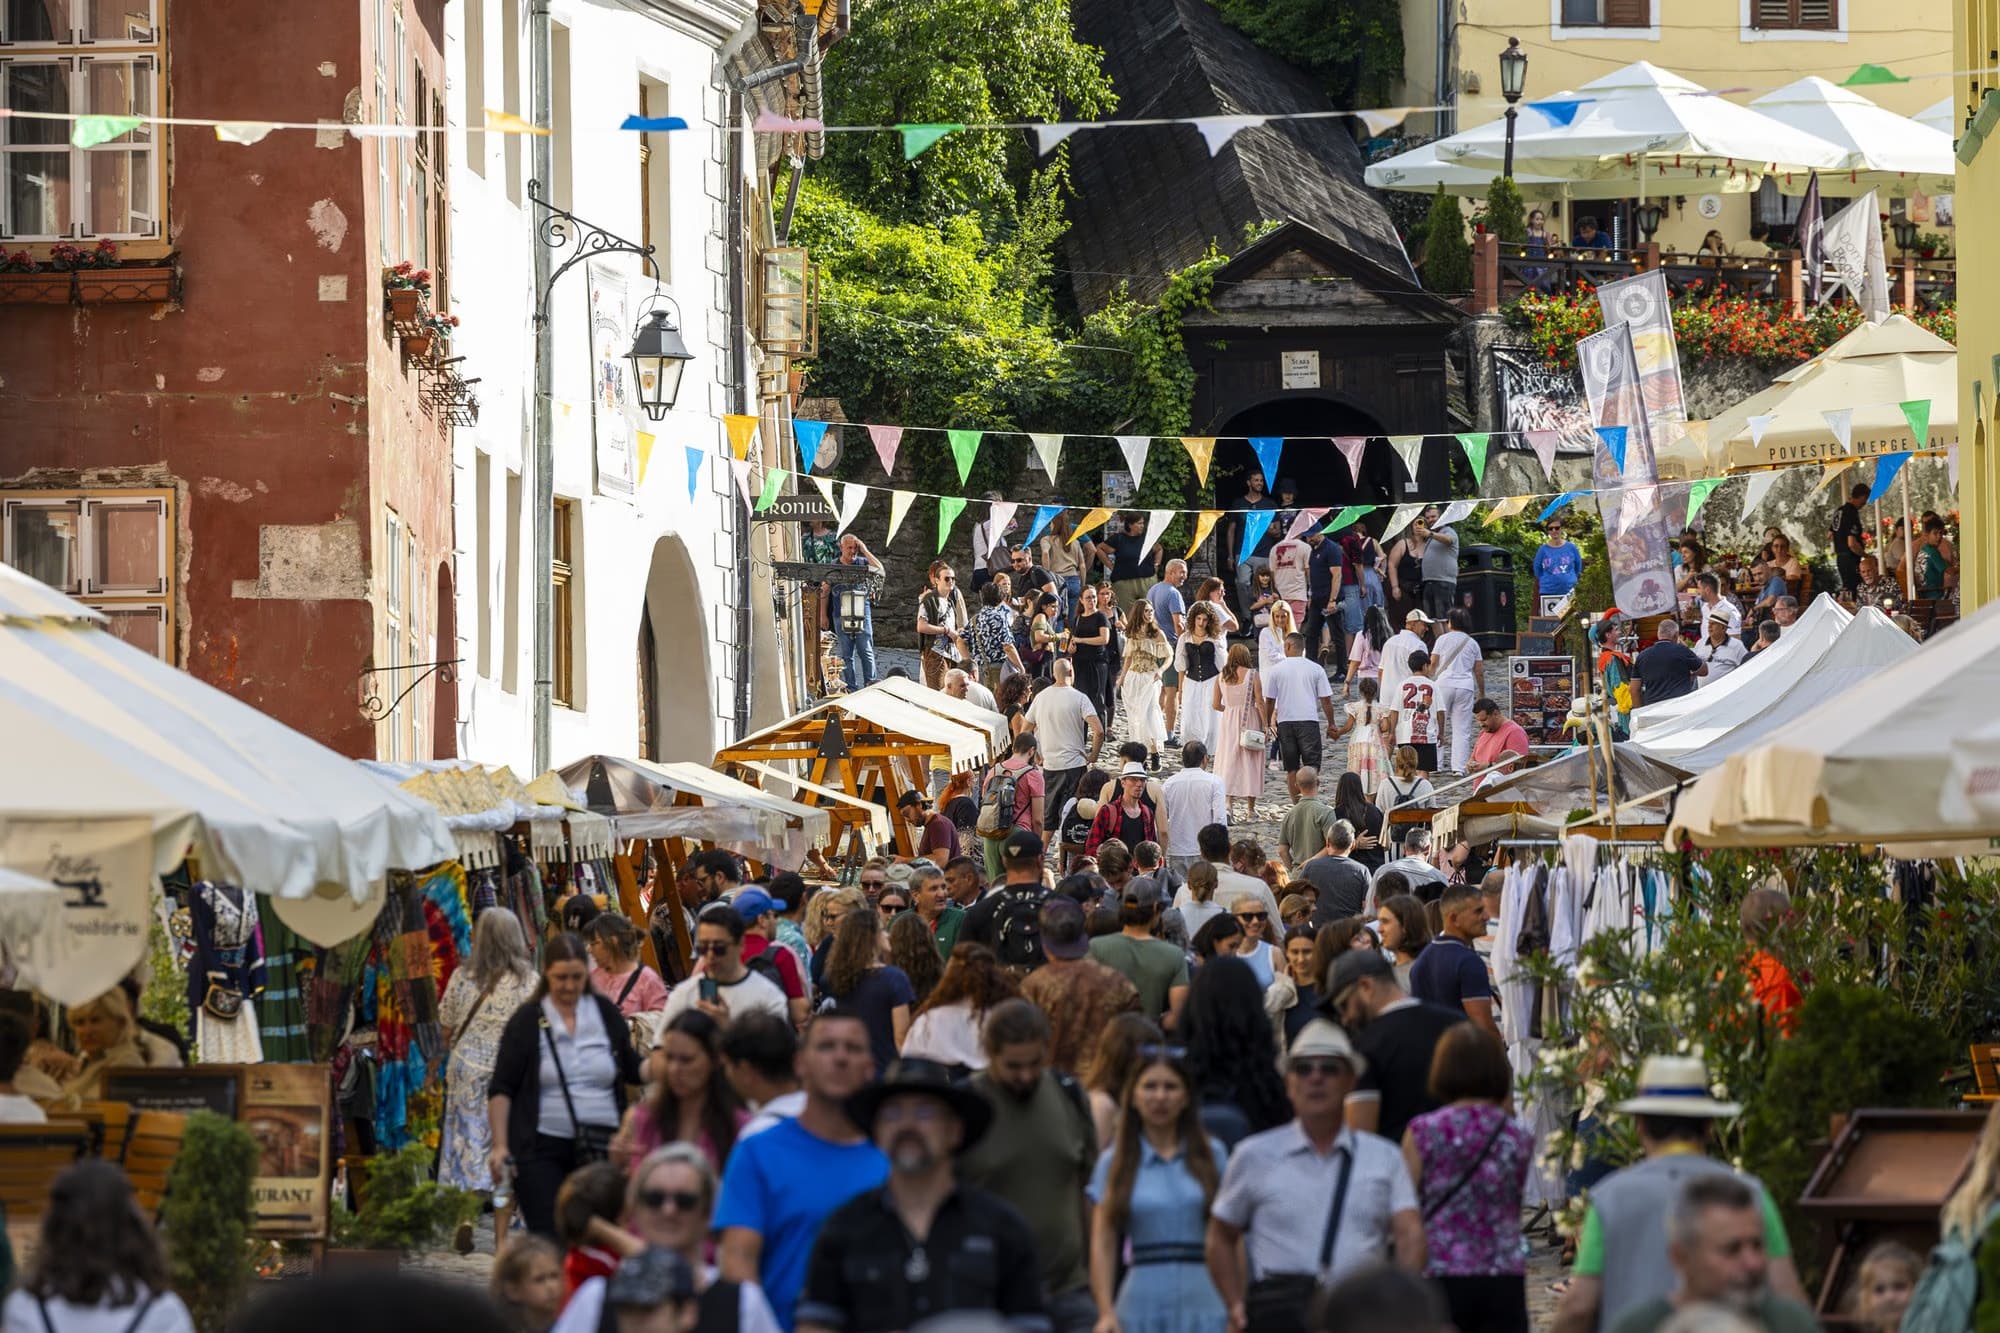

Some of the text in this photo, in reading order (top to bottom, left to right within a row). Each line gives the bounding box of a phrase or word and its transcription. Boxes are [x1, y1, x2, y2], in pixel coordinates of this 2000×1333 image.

[1769, 444, 1847, 460] POVESTEA
[1857, 438, 1908, 454] MERGE
[254, 1188, 314, 1203] URANT
